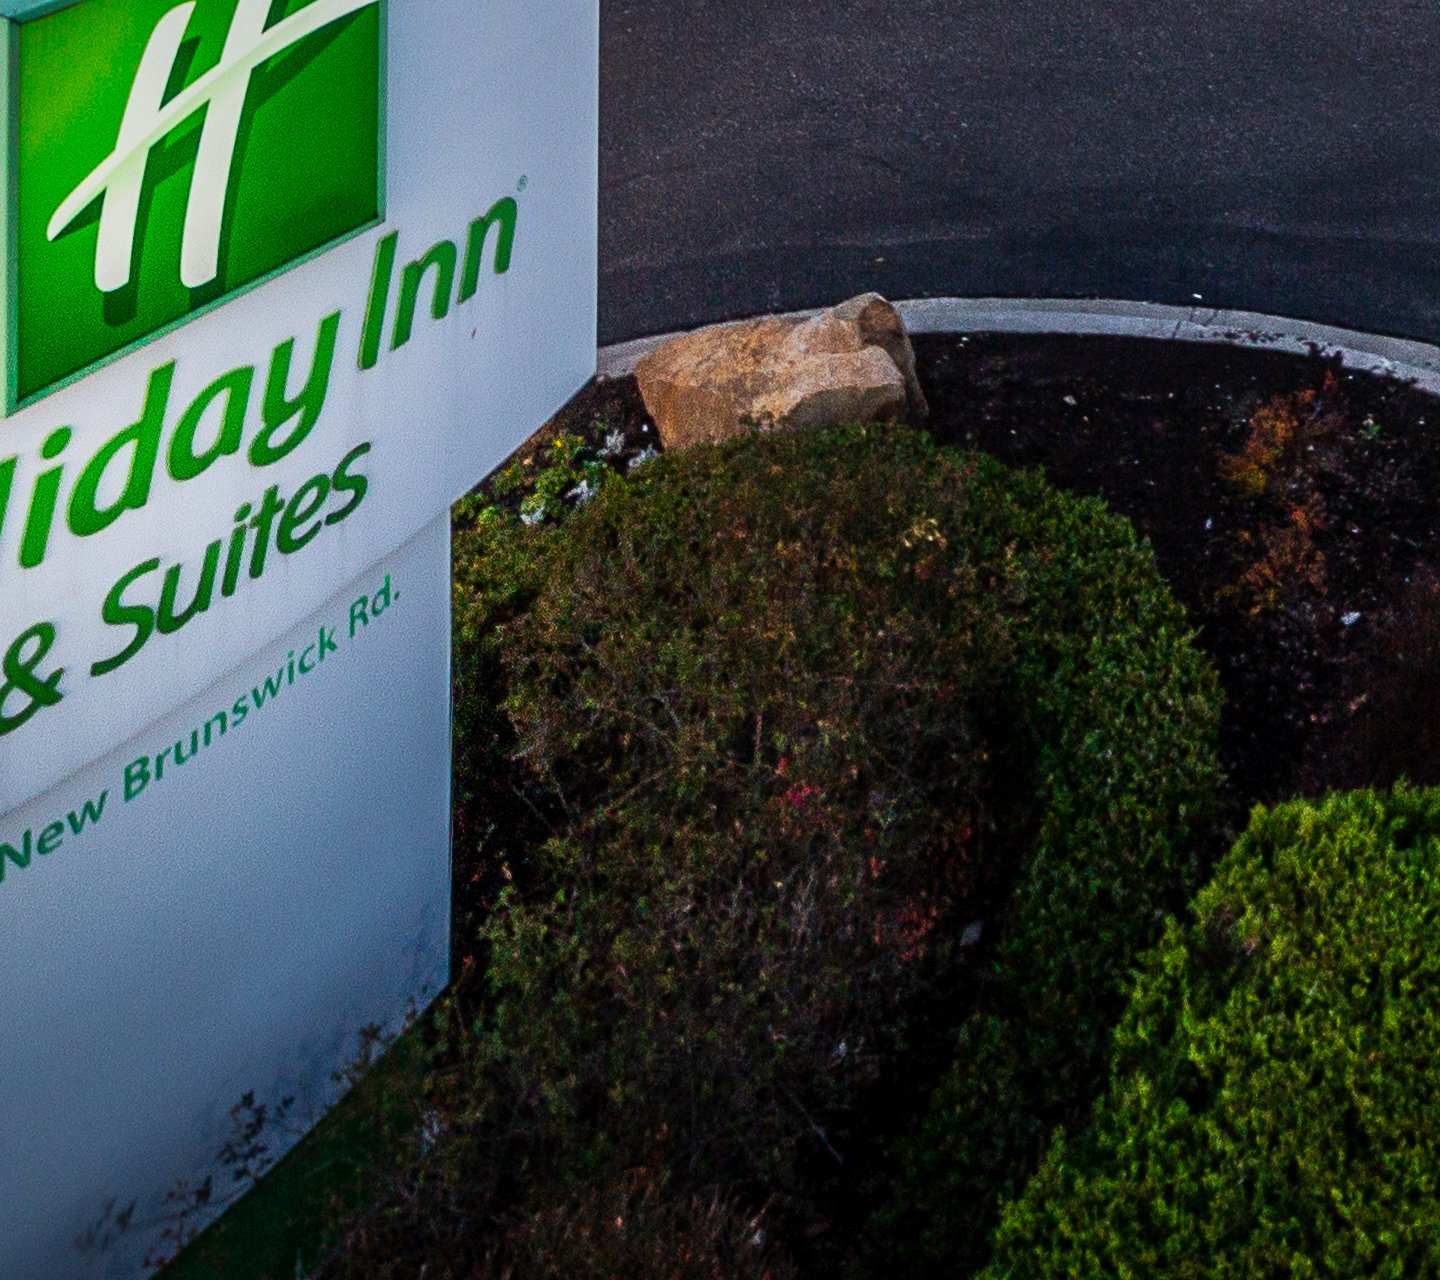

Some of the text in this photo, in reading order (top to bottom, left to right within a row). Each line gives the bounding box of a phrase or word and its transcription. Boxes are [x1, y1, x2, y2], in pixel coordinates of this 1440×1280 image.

[356, 194, 519, 371] Inn
[90, 441, 373, 678] Suites
[122, 627, 339, 803] Brunswick
[347, 571, 401, 639] Rd.
